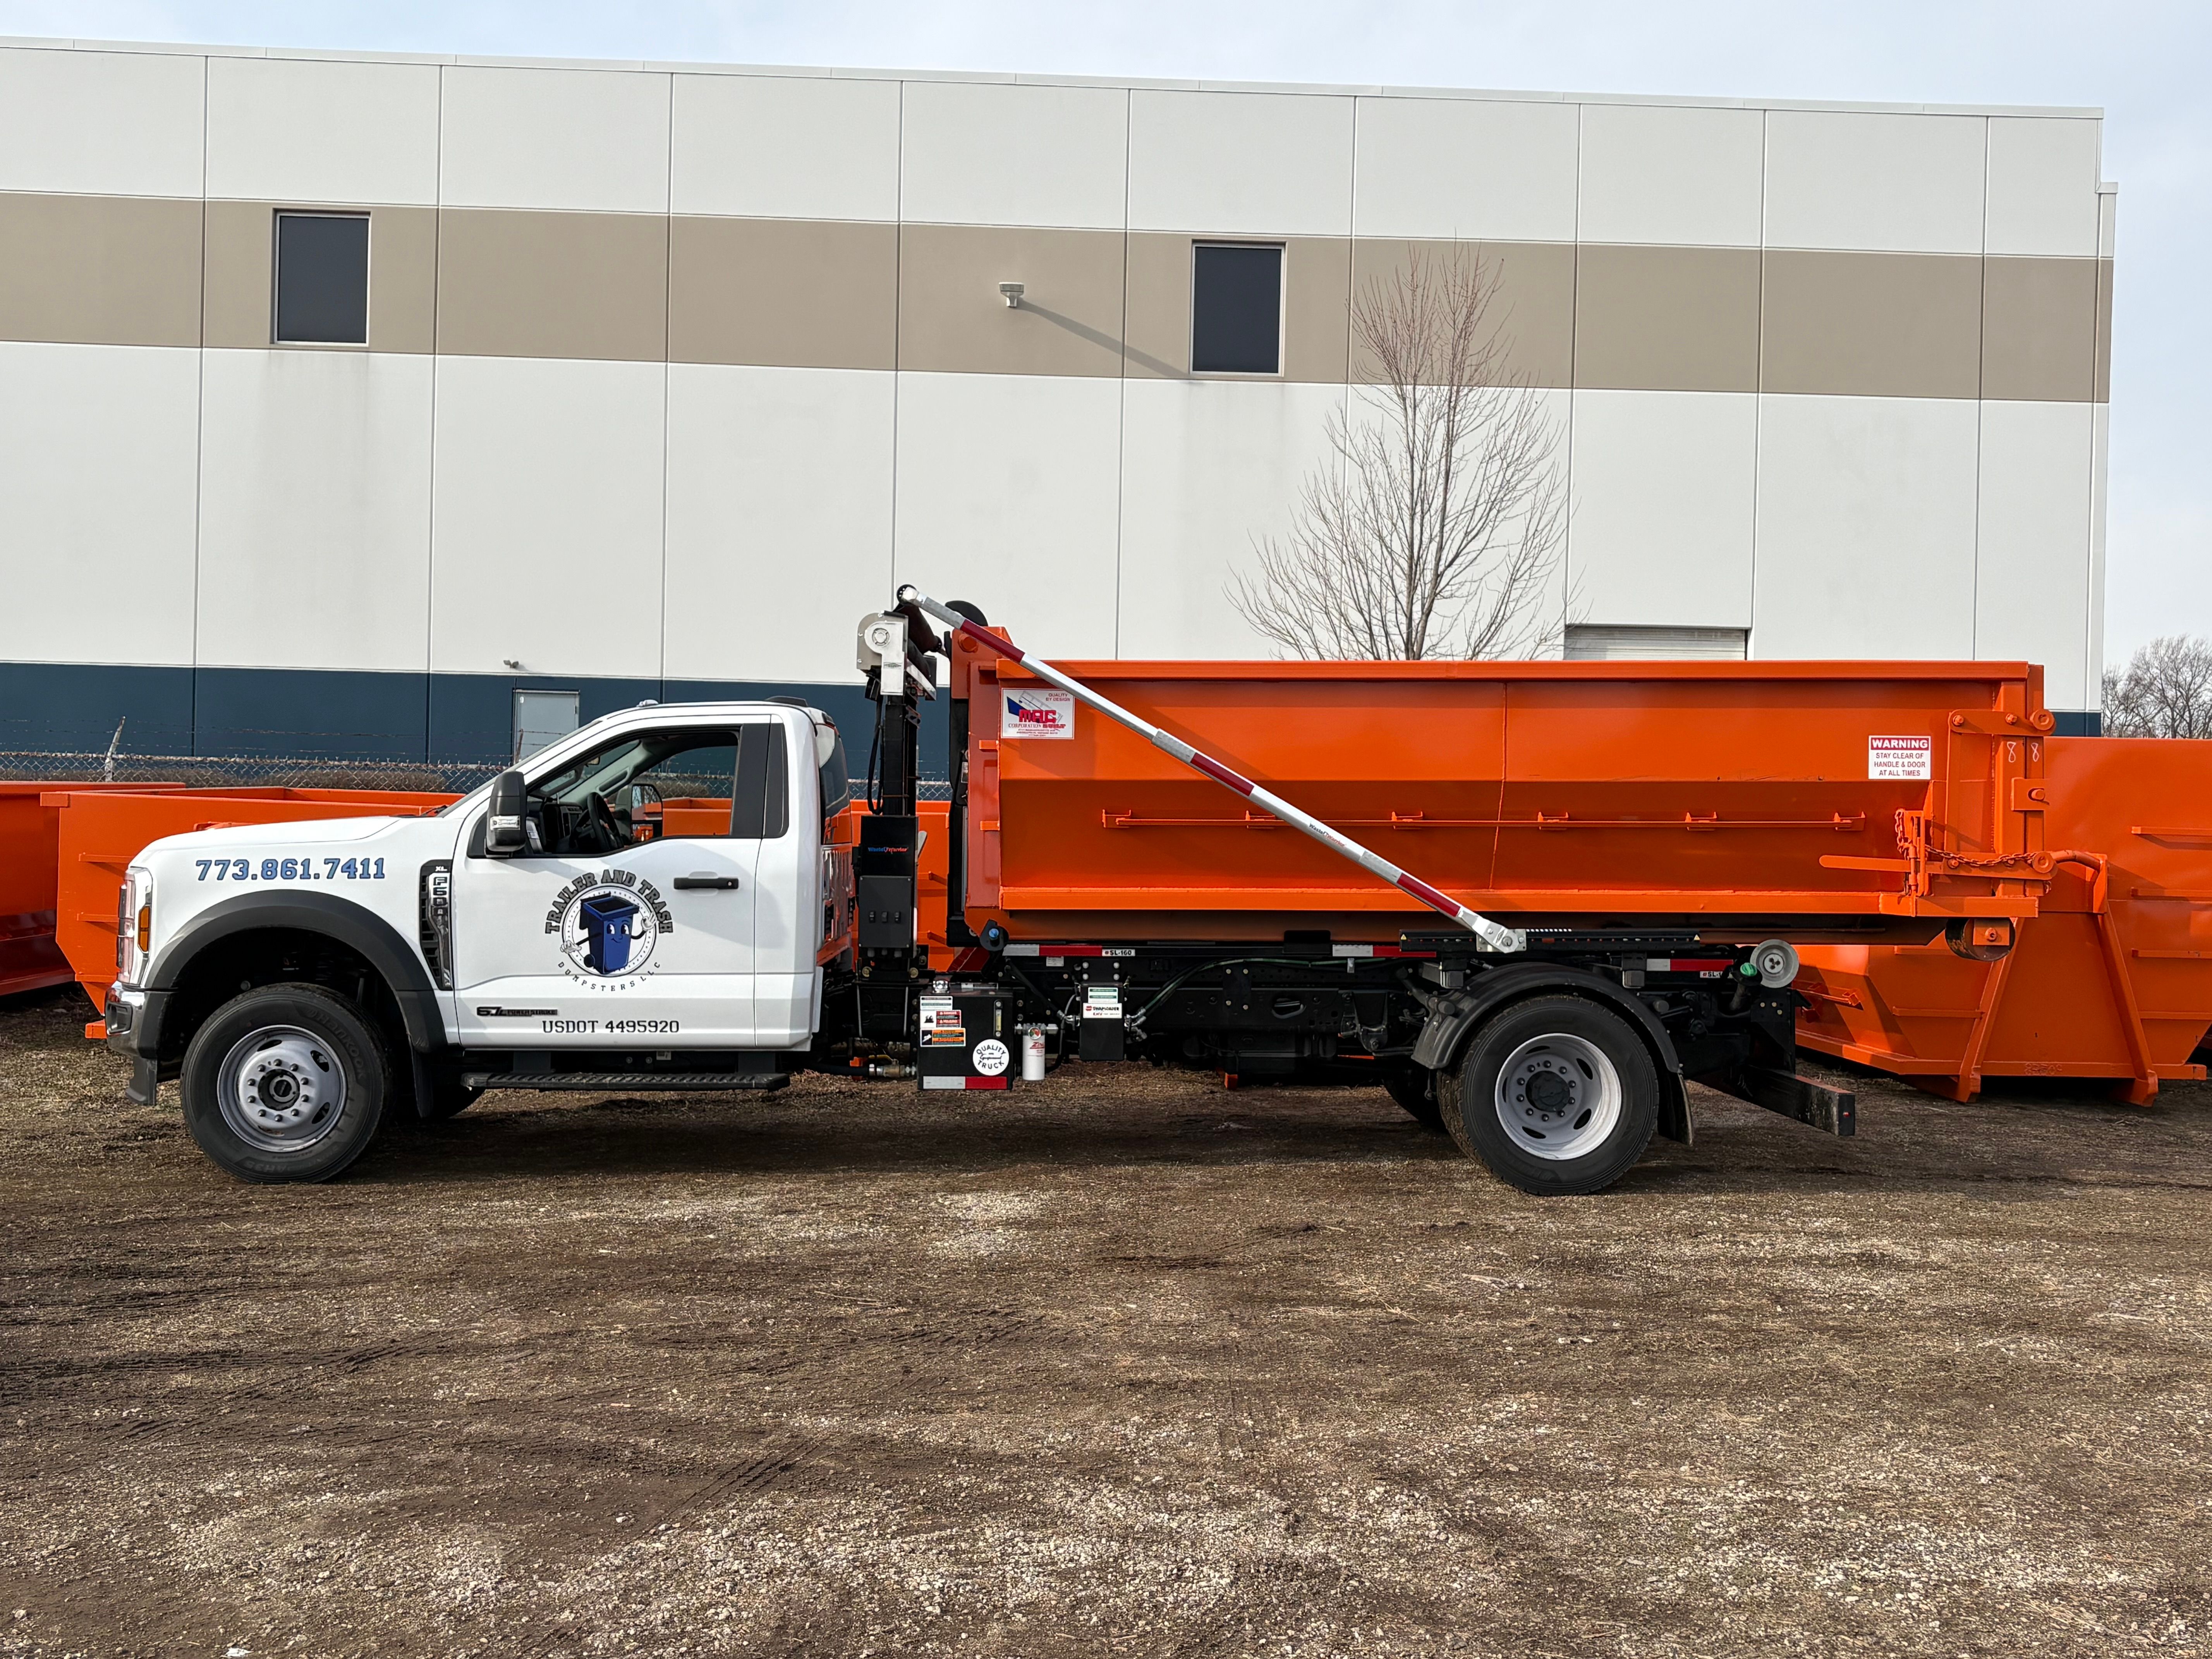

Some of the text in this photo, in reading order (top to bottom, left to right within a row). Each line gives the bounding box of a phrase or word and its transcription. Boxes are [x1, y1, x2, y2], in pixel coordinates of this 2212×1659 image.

[1019, 709, 1057, 723] MAC
[1872, 739, 1928, 749] WARNING
[2007, 741, 2016, 763] 8
[2031, 742, 2040, 763] 8
[196, 858, 385, 881] 773.861.7411
[545, 869, 673, 934] TRAILER AND TRASH
[558, 962, 660, 991] DUMPSTERS LLC
[542, 1020, 680, 1033] USDOT 4495920
[976, 1044, 1006, 1055] QUALITY
[977, 1060, 1005, 1069] TRUCK
